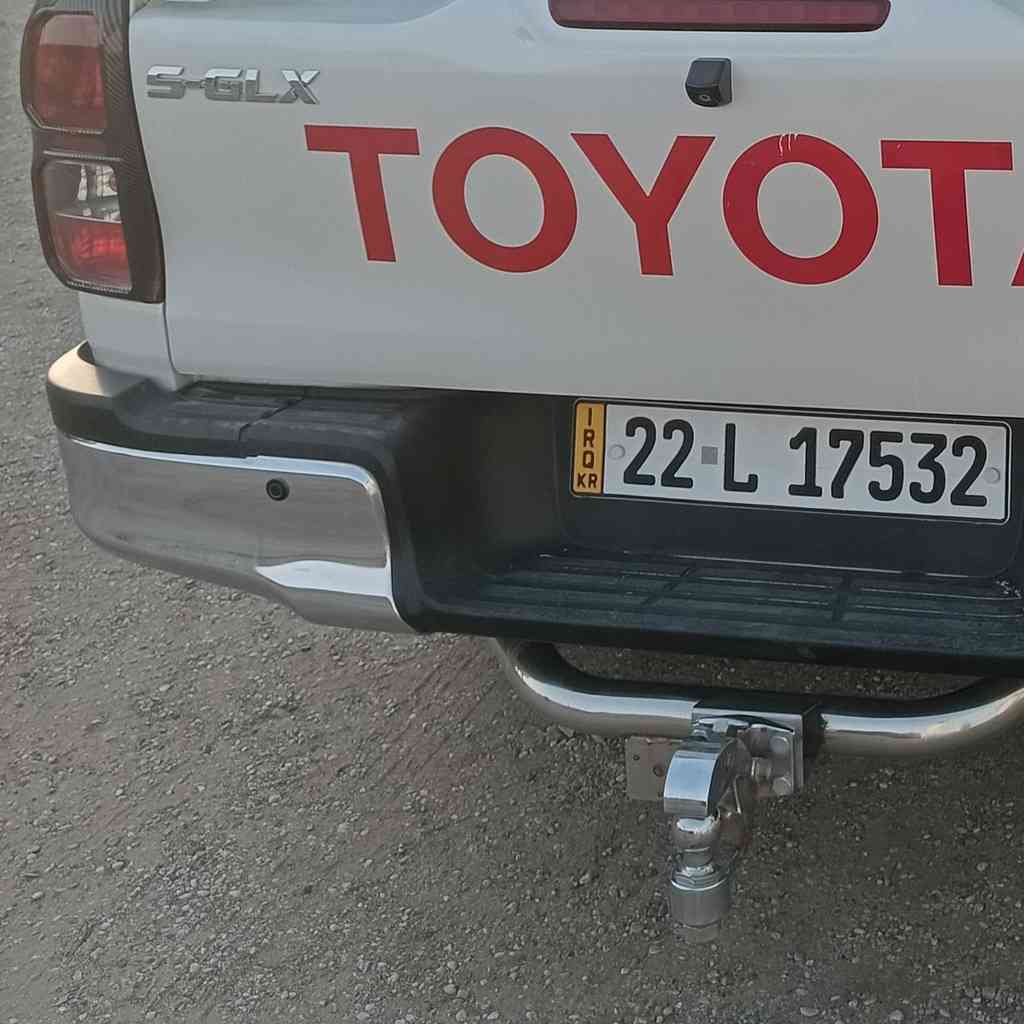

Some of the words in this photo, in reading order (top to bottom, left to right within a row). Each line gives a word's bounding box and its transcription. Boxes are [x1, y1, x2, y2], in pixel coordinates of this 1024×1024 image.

[146, 64, 321, 106] S-GLX
[582, 406, 596, 469] IRQ
[622, 416, 695, 489] 22
[723, 423, 759, 494] L
[788, 426, 989, 508] 17532
[576, 472, 599, 490] KR
